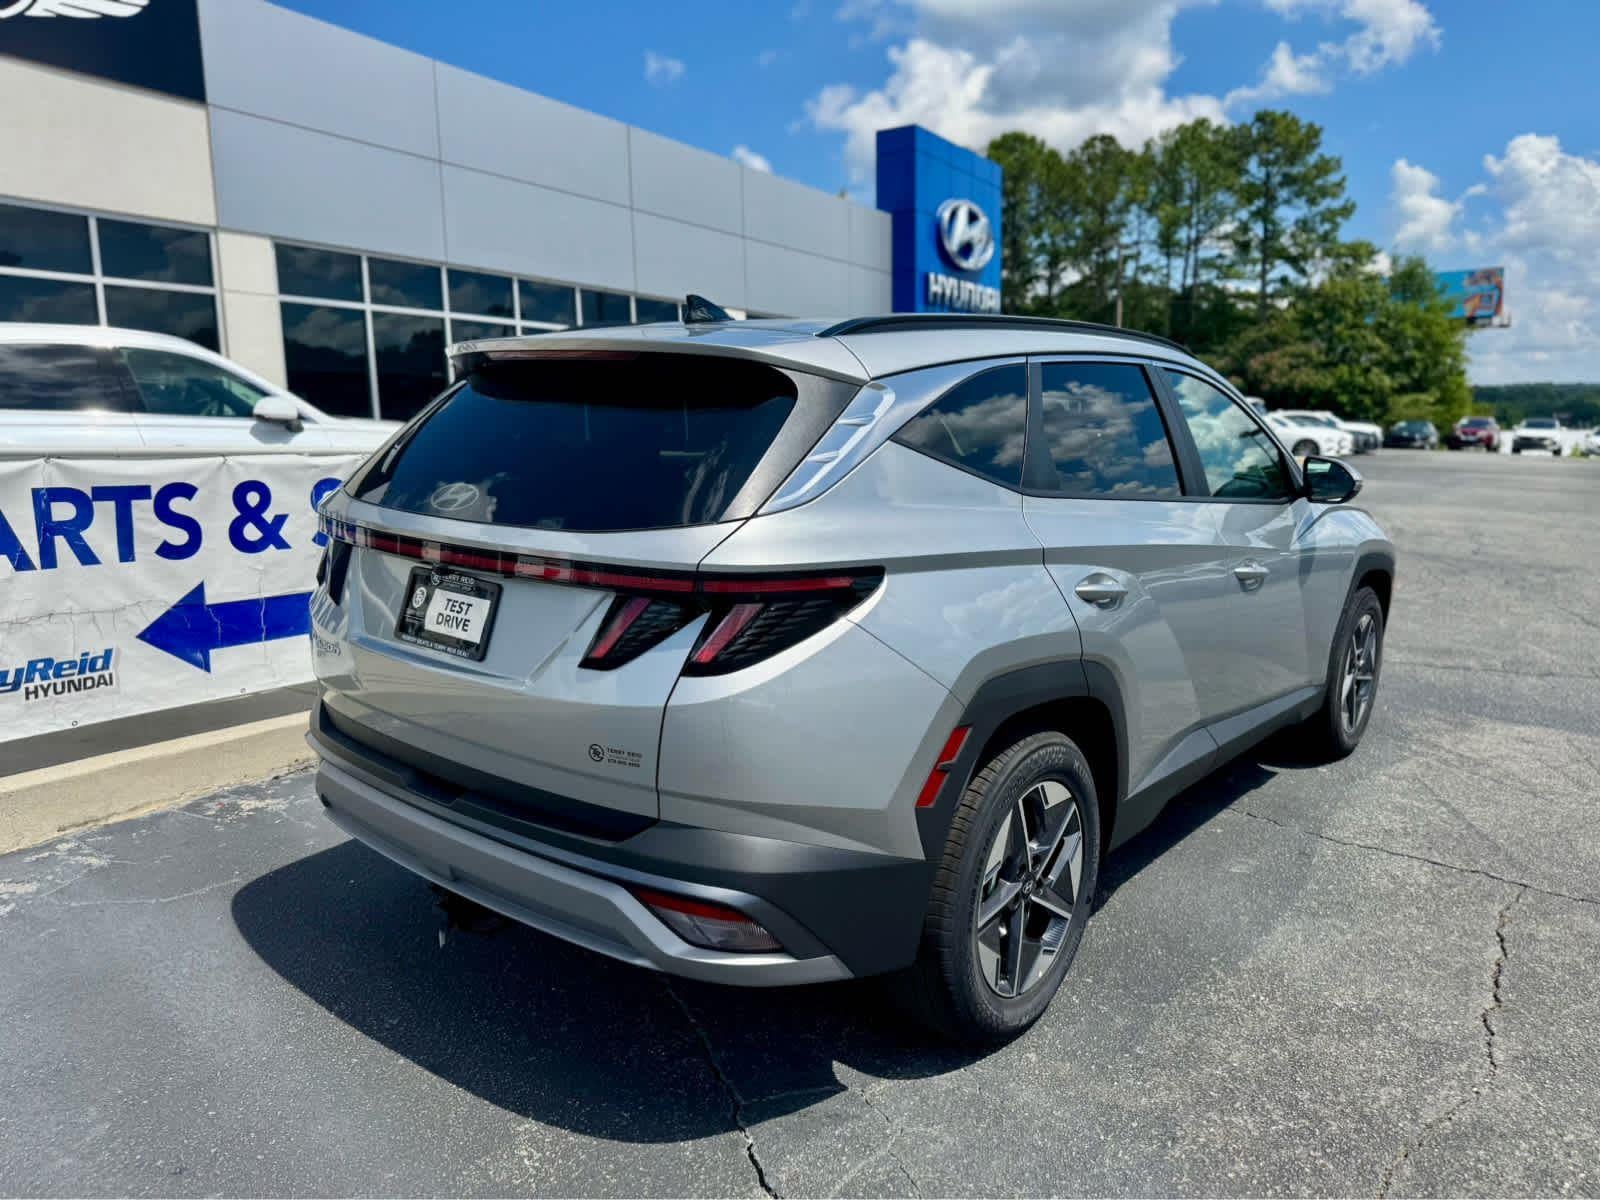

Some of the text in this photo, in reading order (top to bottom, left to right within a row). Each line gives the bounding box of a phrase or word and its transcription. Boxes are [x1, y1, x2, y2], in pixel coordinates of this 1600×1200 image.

[928, 272, 1001, 313] HYUNDAI
[228, 480, 292, 554] &
[445, 598, 473, 616] TEST
[436, 613, 471, 632] DRIVE
[25, 673, 113, 701] HYUNDAI
